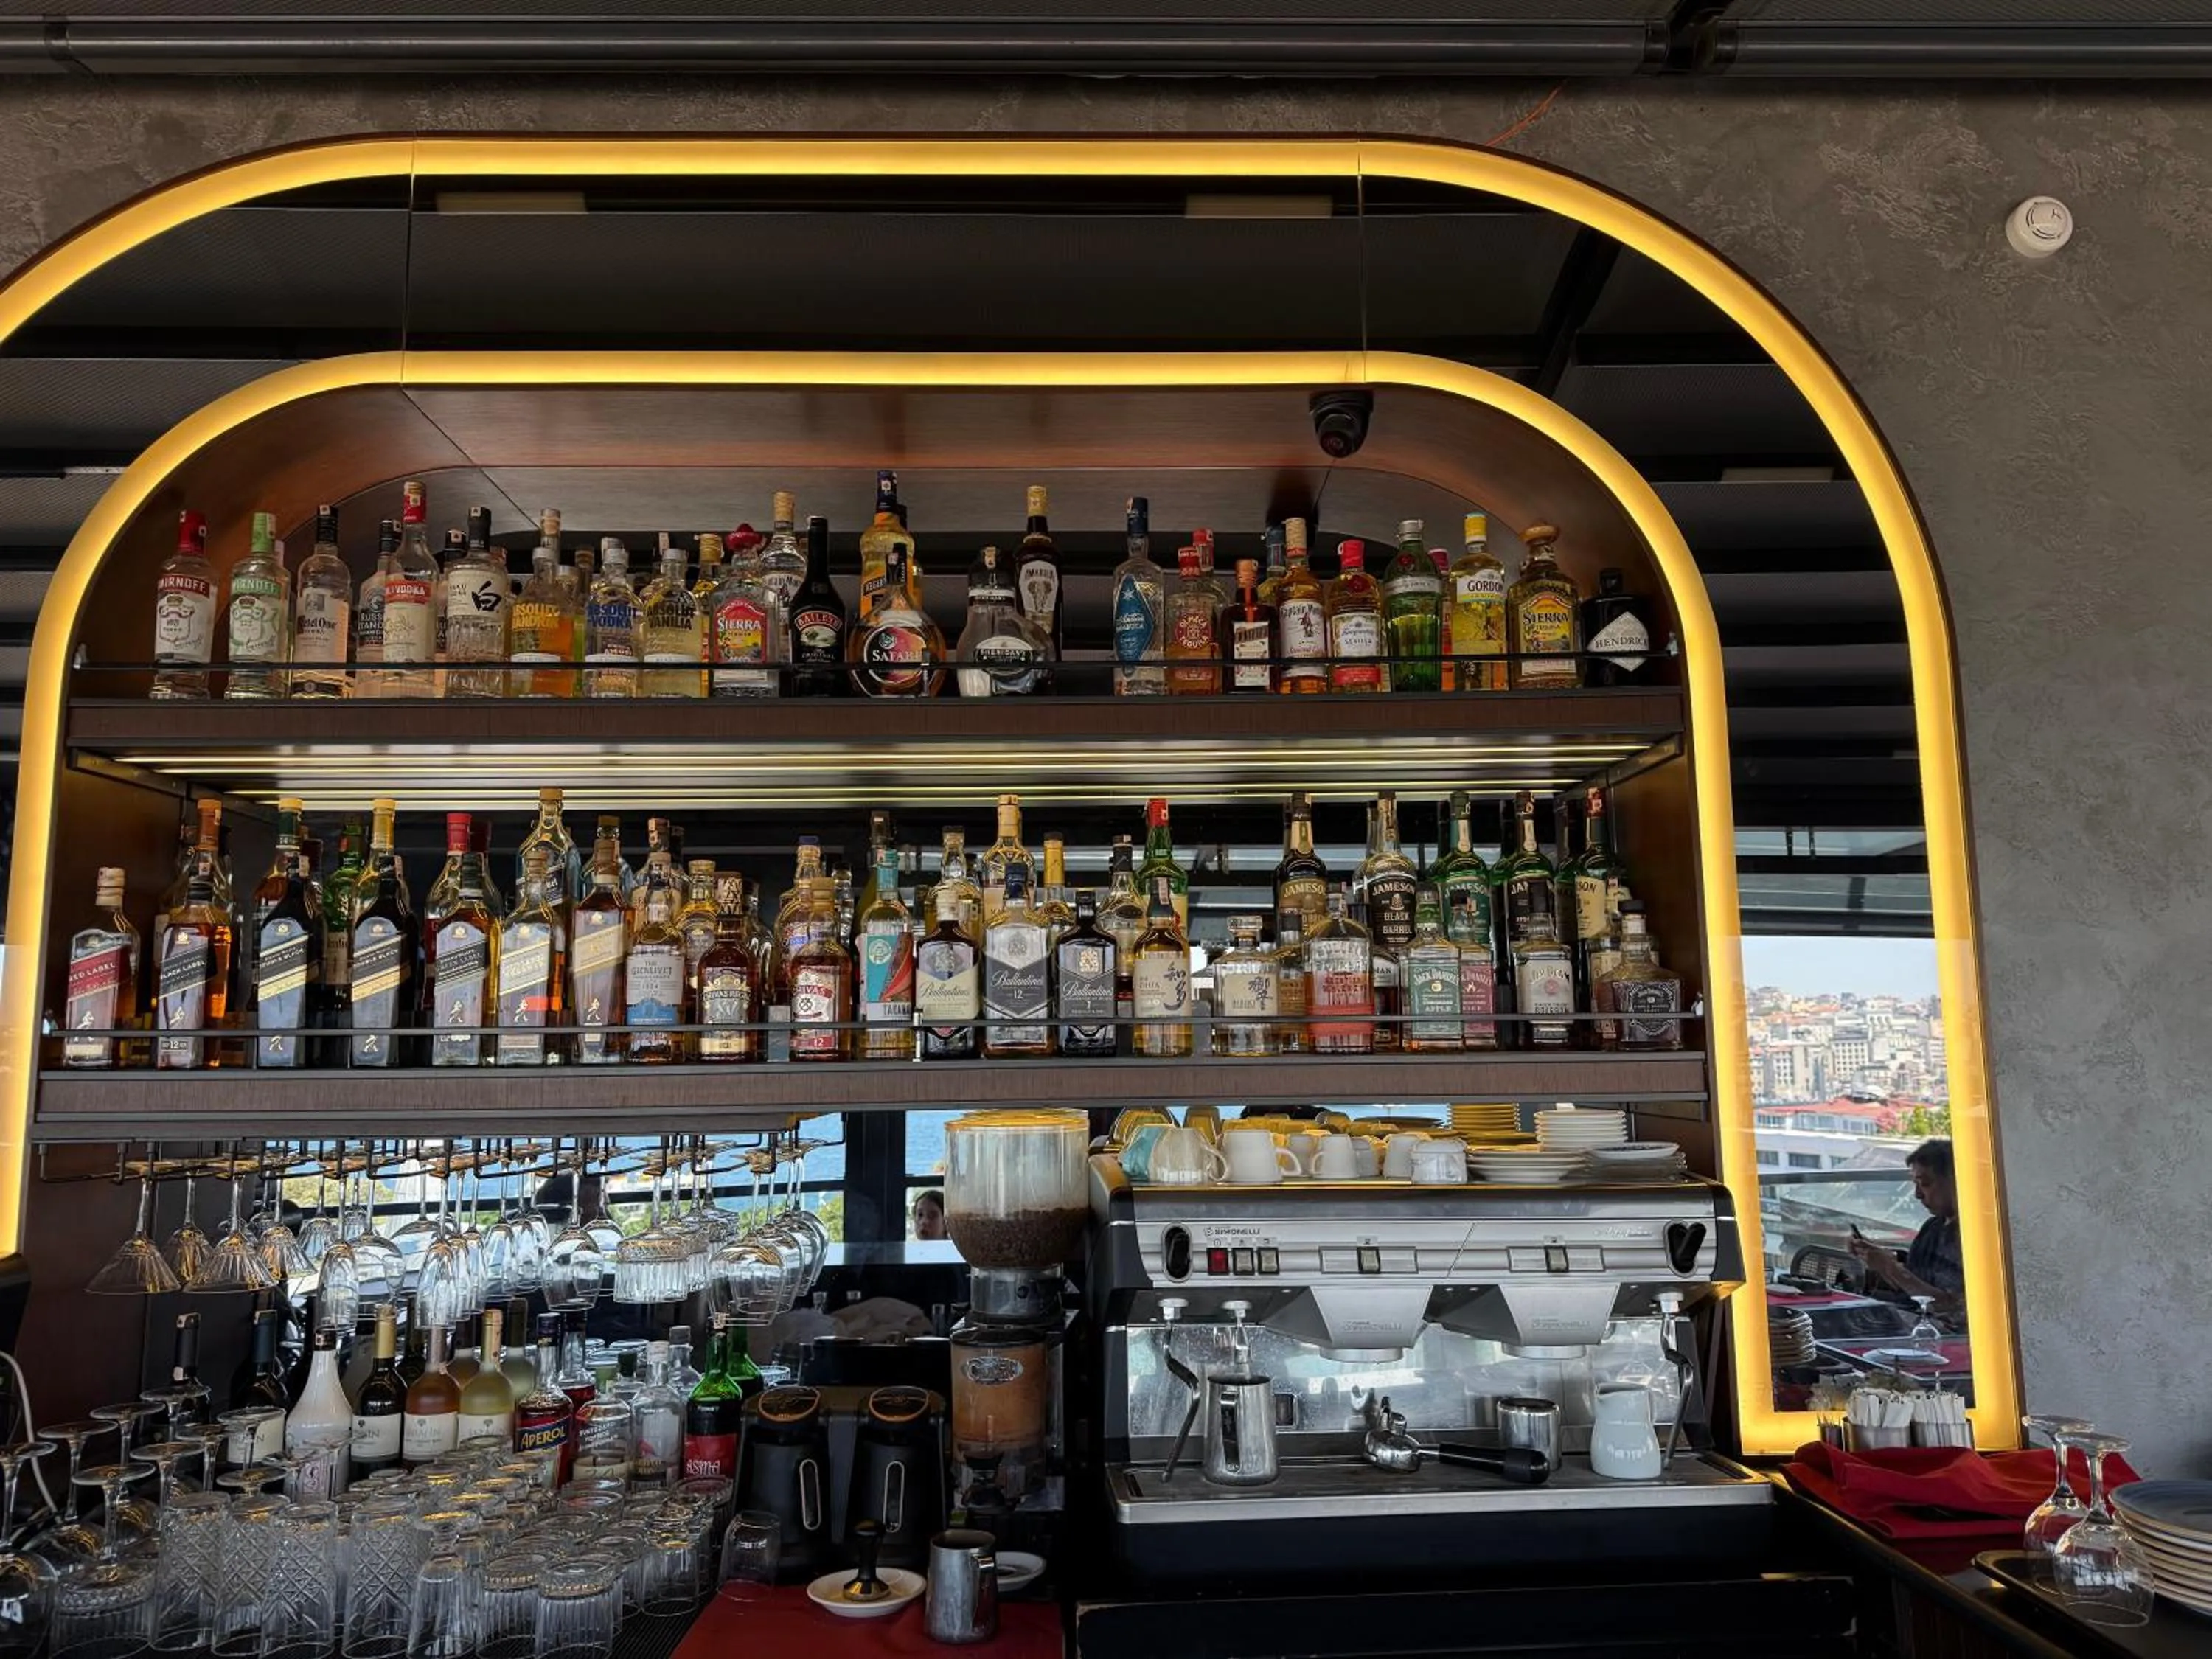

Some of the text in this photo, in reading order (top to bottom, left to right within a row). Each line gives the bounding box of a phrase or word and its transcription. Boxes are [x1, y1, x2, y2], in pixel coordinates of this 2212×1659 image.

[395, 586, 425, 596] VODKA
[647, 605, 694, 619] ABSOLUT
[592, 615, 633, 629] VODKA
[797, 613, 840, 628] BAILEYS
[1523, 612, 1569, 625] SIERRA
[717, 619, 761, 631] SIERRA
[872, 650, 923, 661] SAFARI
[1284, 883, 1326, 897] JAMESO
[1371, 881, 1415, 896] JAMESON
[1384, 913, 1410, 921] BLACK
[1382, 926, 1412, 934] BARREL
[86, 961, 116, 975] LABEL
[183, 959, 206, 972] LABEL
[632, 966, 672, 975] GLENLIVET
[1013, 990, 1023, 999] 12
[170, 1040, 179, 1049] 12
[813, 1038, 824, 1046] 12
[520, 1425, 566, 1449] APEROL
